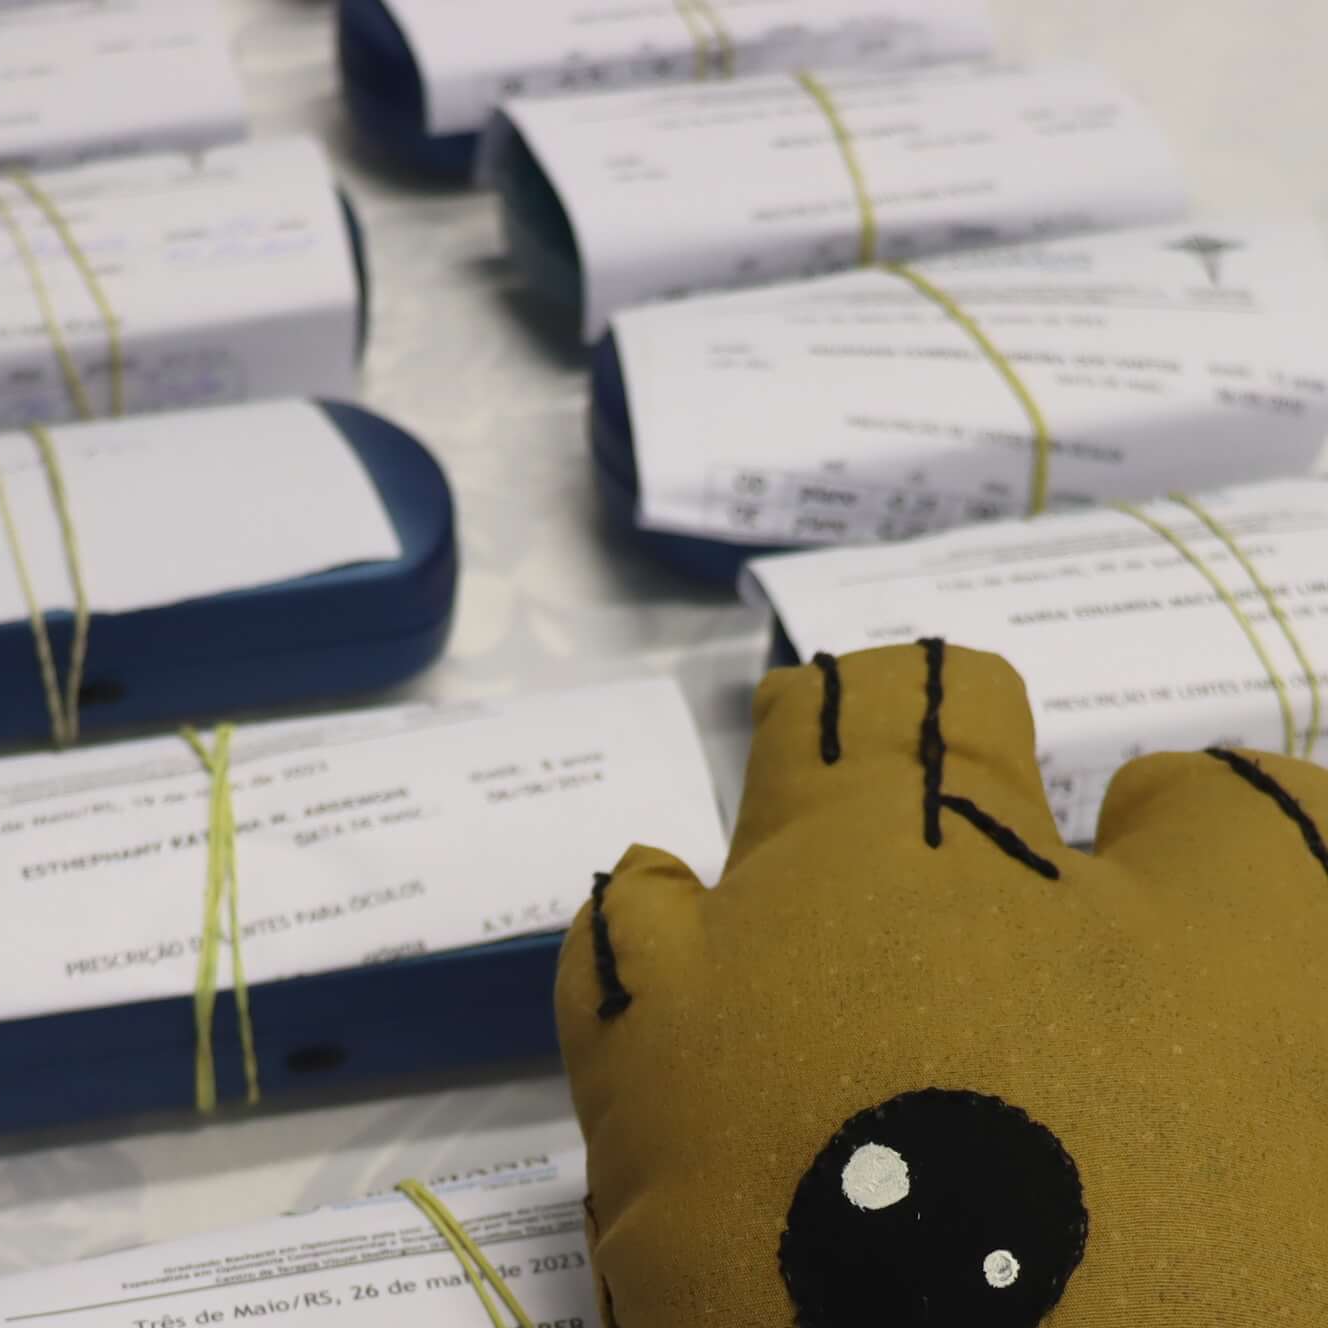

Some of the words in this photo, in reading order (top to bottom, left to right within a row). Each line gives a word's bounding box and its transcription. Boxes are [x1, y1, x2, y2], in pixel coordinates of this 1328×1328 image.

[195, 1308, 224, 1326] de
[234, 1290, 342, 1320] Maio/RS,
[351, 1284, 380, 1302] 26
[388, 1279, 417, 1297] de
[426, 1270, 472, 1290] mai
[529, 1252, 585, 1275] 2023
